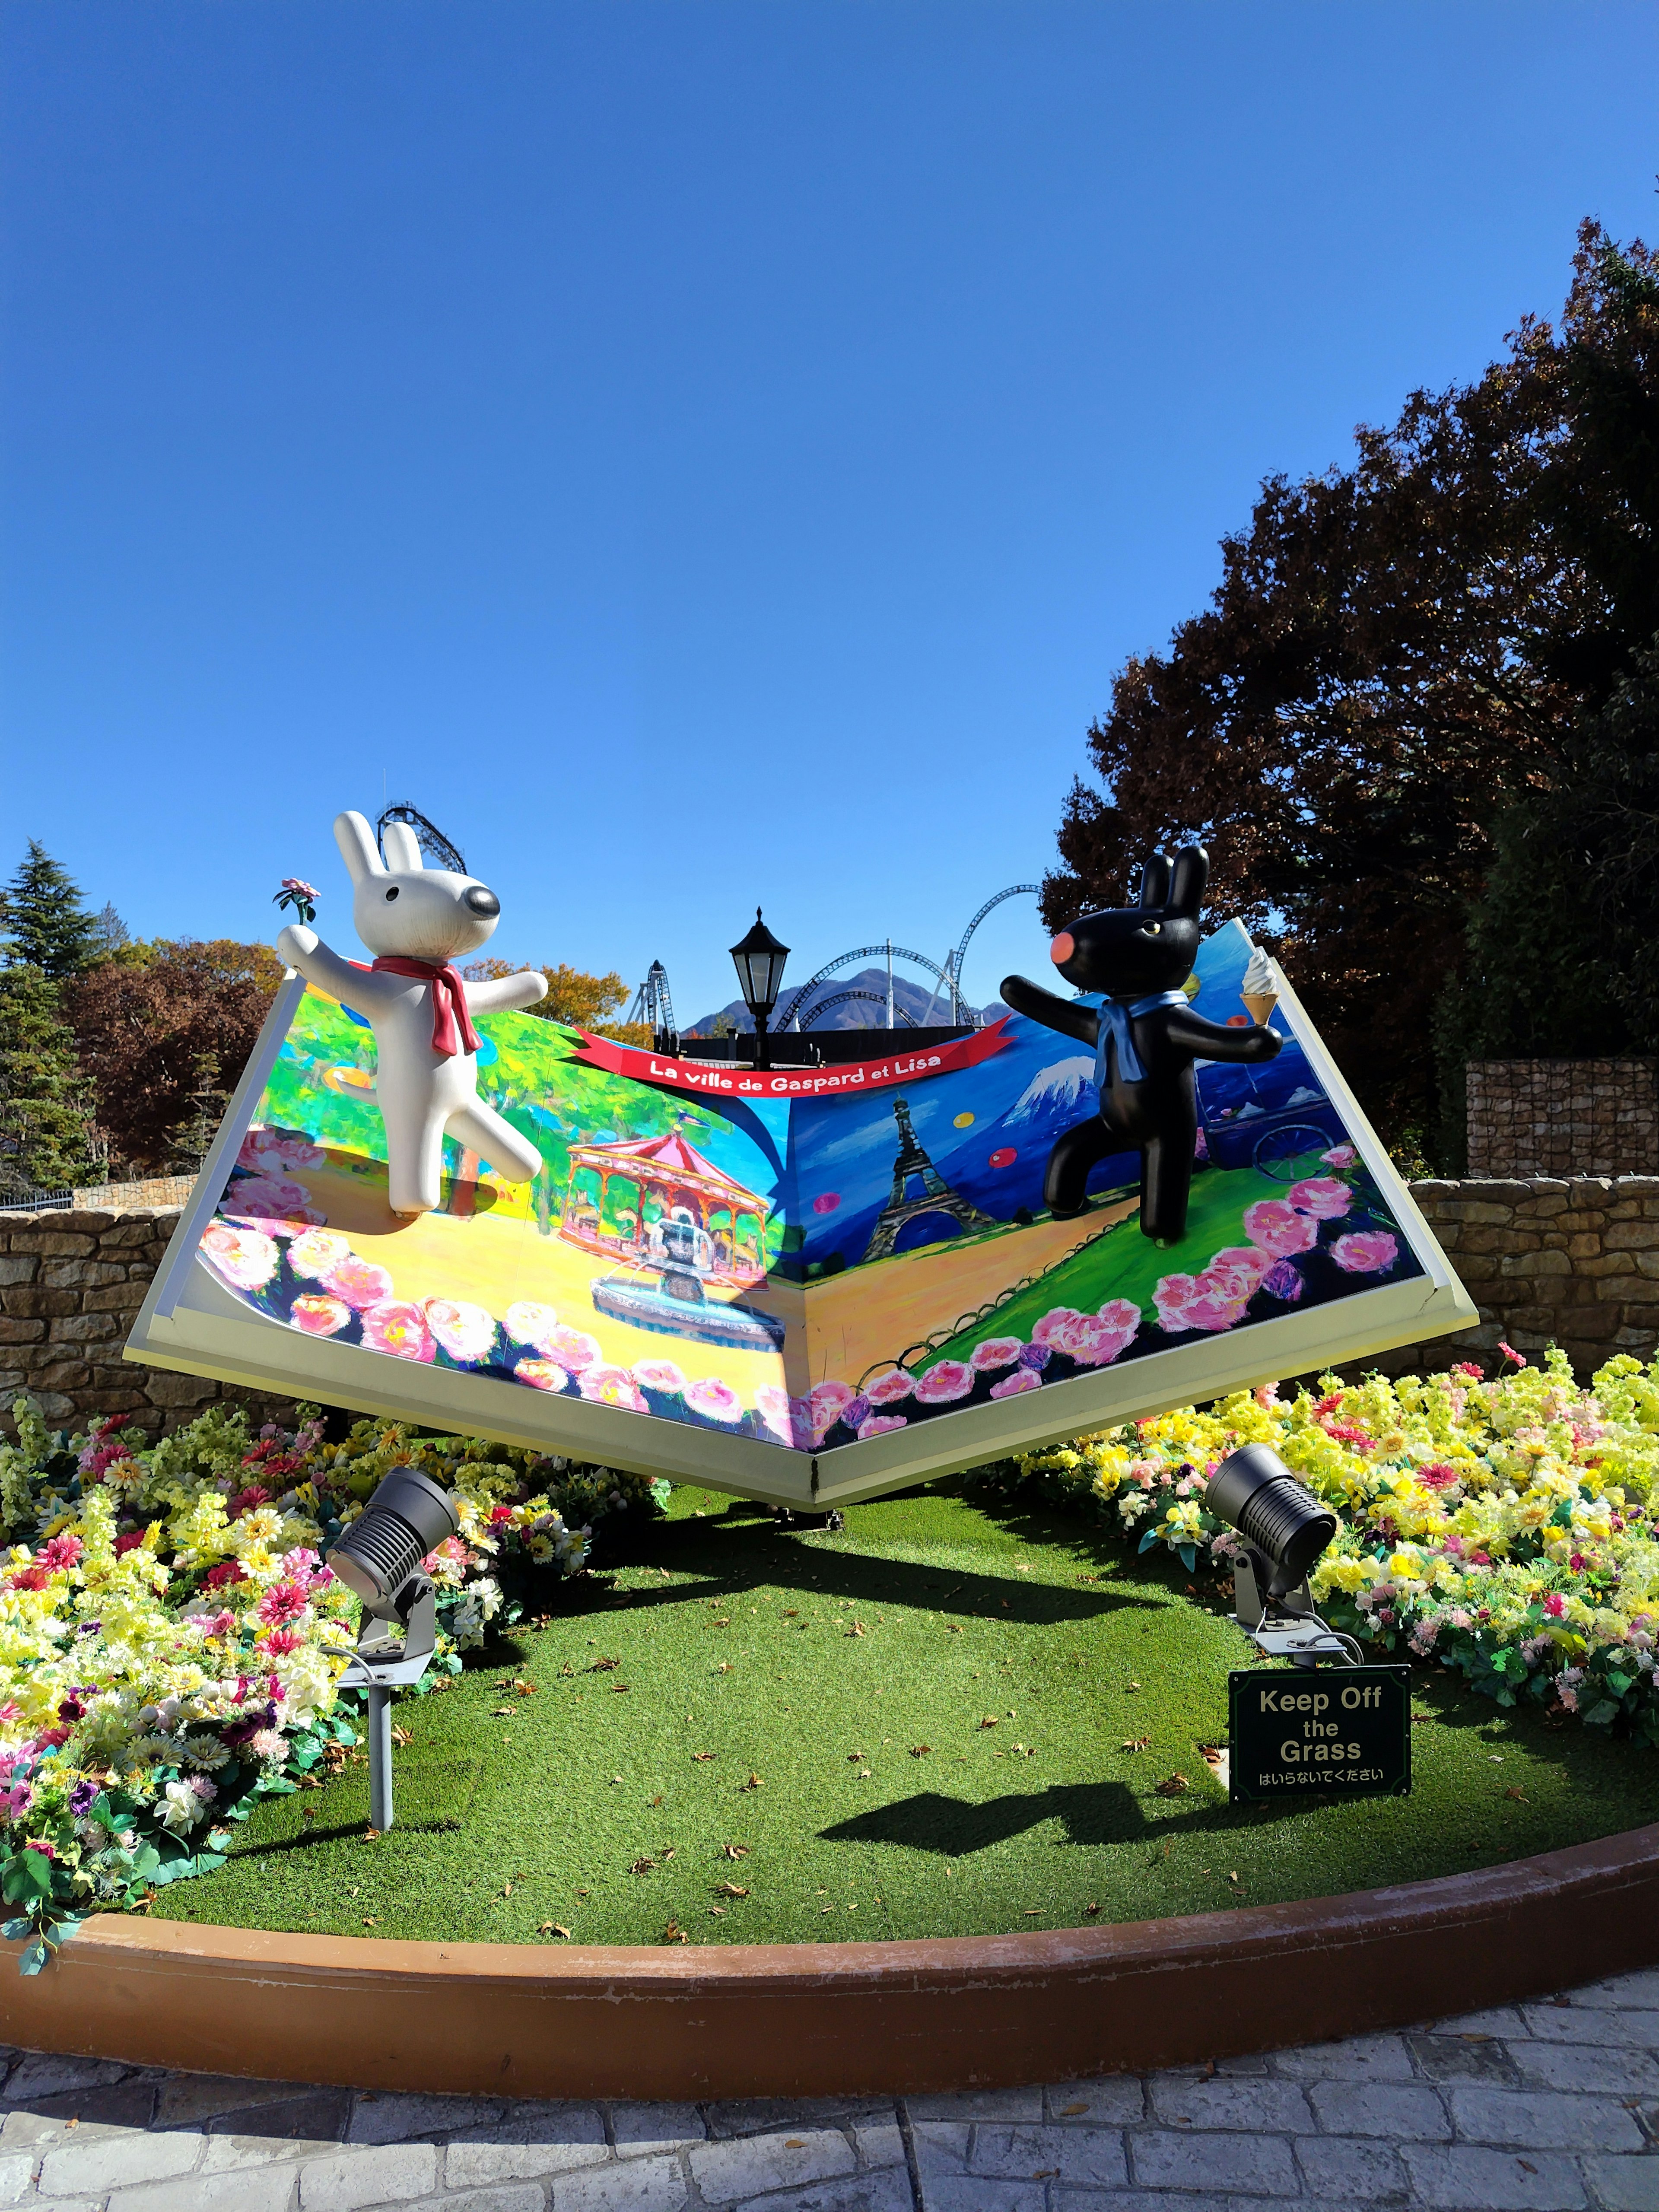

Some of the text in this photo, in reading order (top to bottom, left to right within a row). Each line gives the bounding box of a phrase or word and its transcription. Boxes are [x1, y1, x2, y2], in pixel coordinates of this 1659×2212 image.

[650, 1056, 941, 1093] La ville de Gaspard et Lisa
[1260, 1686, 1382, 1716] Keep Off
[1303, 1719, 1339, 1738] the
[1280, 1740, 1361, 1763] Grass
[1259, 1768, 1384, 1786] はいらないでください
